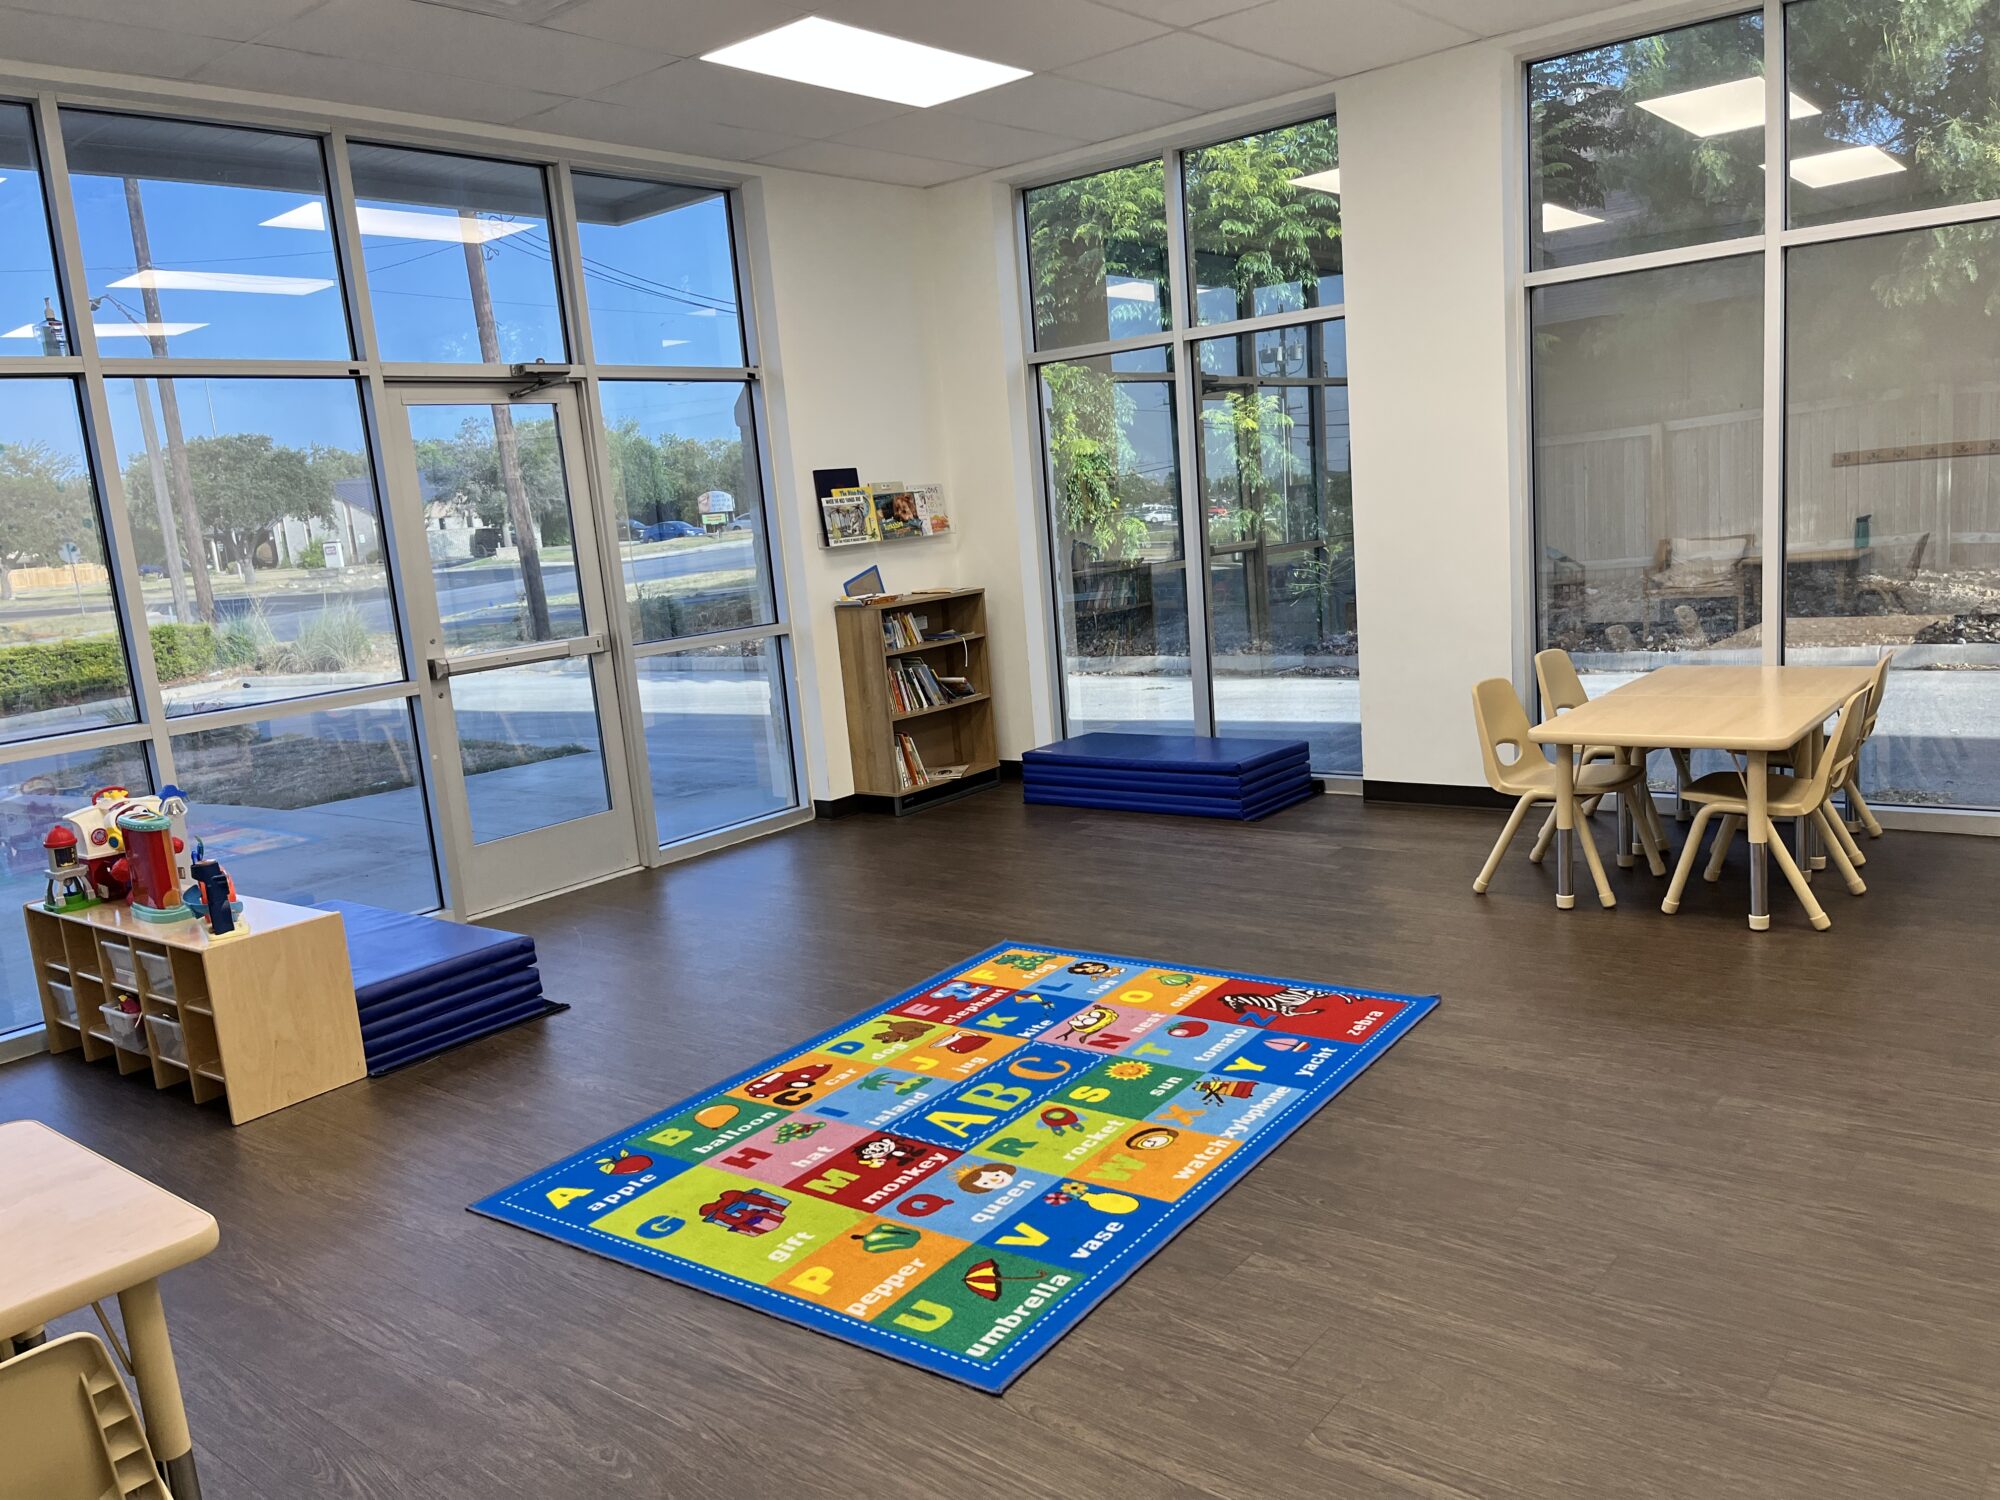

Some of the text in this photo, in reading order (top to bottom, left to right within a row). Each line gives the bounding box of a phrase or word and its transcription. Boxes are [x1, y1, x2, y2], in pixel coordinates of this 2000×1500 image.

[970, 970, 999, 981] F
[1022, 962, 1057, 980] frog
[1037, 982, 1073, 992] L
[1086, 978, 1118, 996] lion
[1119, 990, 1154, 1004] O
[1170, 984, 1208, 1008] onion
[902, 1003, 941, 1015] E
[942, 987, 1010, 1025] elephant
[976, 1012, 1019, 1029] K
[1017, 1017, 1054, 1039] kite
[1134, 1011, 1167, 1035] nest
[1238, 1011, 1278, 1027] Z
[1345, 1009, 1384, 1037] zebra
[826, 1040, 865, 1055] D
[871, 1036, 908, 1061] dog
[1087, 1033, 1132, 1050] N
[1133, 1042, 1173, 1057] T
[1193, 1026, 1248, 1063] tomato
[909, 1056, 940, 1071] J
[952, 1055, 988, 1074] jug
[1223, 1056, 1268, 1074] Y
[1294, 1046, 1338, 1078] yacht
[823, 1069, 858, 1087] car
[1149, 1075, 1184, 1097] sun
[773, 1090, 813, 1106] C
[1068, 1084, 1111, 1103] S
[814, 1106, 850, 1117] I
[863, 1091, 929, 1127] island
[1156, 1103, 1206, 1126] X
[1219, 1084, 1291, 1140] xylophone
[647, 1127, 693, 1147] B
[692, 1111, 777, 1154] balloon
[1062, 1119, 1125, 1162] rocket
[720, 1147, 773, 1170] H
[790, 1145, 836, 1168] hat
[986, 1137, 1039, 1158] R
[1172, 1137, 1233, 1180] watch
[1089, 1152, 1148, 1182] W
[802, 1168, 860, 1195] M
[862, 1151, 948, 1207] monkey
[544, 1187, 595, 1210] A
[587, 1174, 657, 1211] apple
[970, 1178, 1036, 1224] queen
[896, 1193, 954, 1218] Q
[636, 1215, 686, 1239] G
[994, 1222, 1050, 1247] V
[768, 1231, 816, 1263] gift
[1069, 1220, 1125, 1260] vase
[787, 1266, 833, 1295] P
[844, 1256, 926, 1317] pepper
[893, 1299, 953, 1332] U
[965, 1272, 1072, 1358] umbrella
